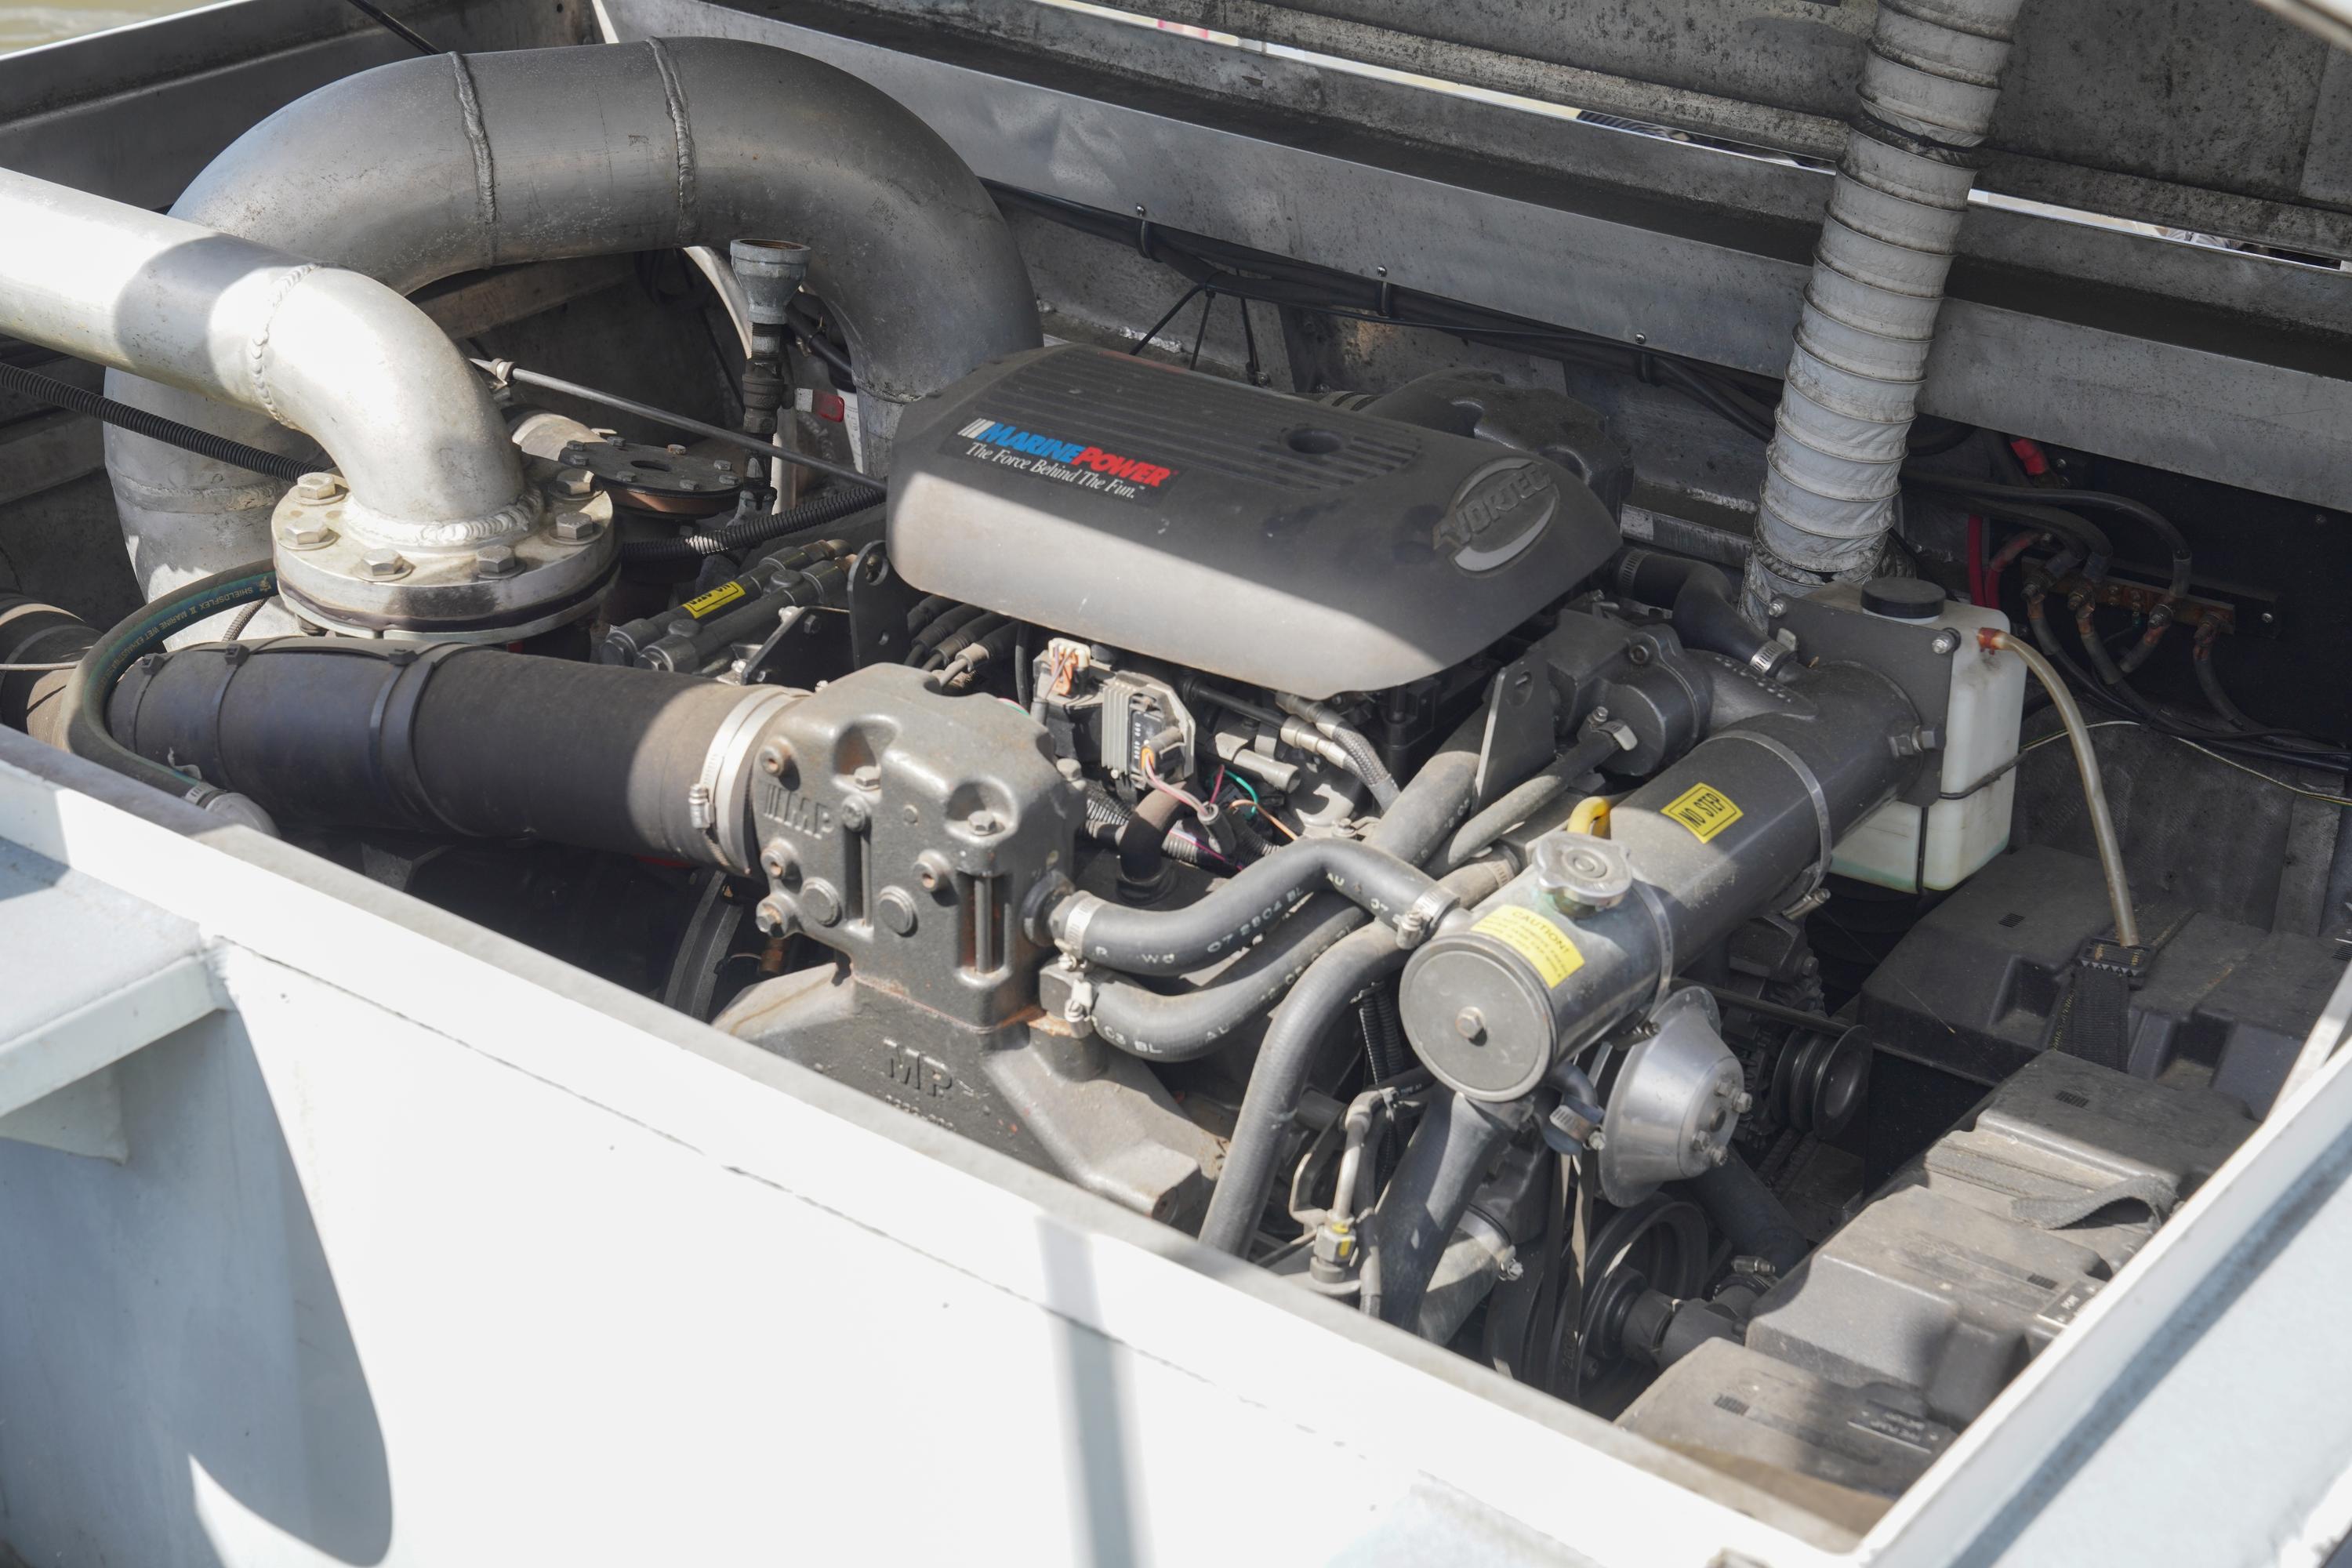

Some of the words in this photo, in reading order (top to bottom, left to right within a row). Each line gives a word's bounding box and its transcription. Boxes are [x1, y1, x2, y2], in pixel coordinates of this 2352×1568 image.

[966, 441, 989, 459] The
[993, 448, 1032, 470] Force
[1031, 459, 1082, 483] Behind
[1077, 470, 1106, 490] The
[1433, 461, 1552, 547] VORTEC
[144, 626, 162, 641] WET
[160, 612, 188, 630] MARINE
[1679, 808, 1706, 829] NO
[1693, 793, 1726, 818] STEP
[883, 1038, 954, 1097] MP
